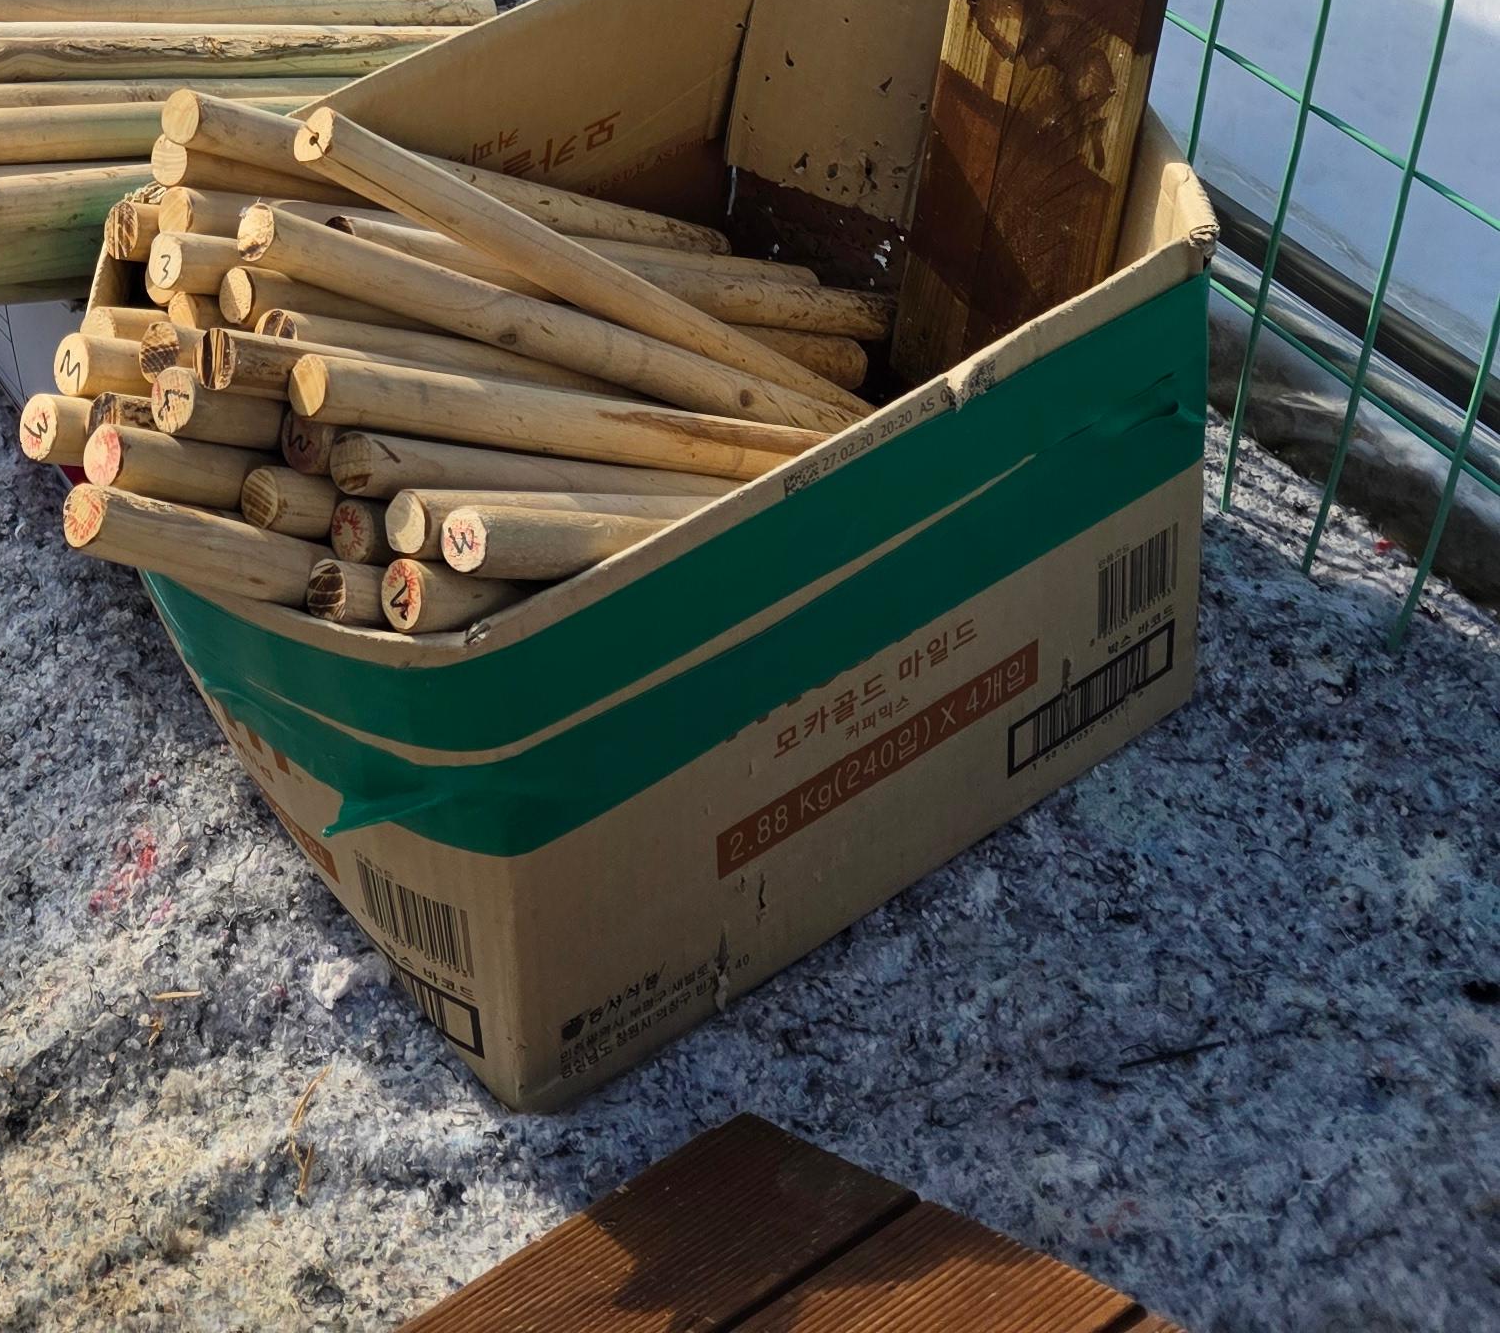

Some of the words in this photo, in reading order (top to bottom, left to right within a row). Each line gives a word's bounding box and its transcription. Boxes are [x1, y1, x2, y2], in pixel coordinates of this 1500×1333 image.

[821, 433, 875, 471] 27.02.20
[879, 410, 913, 439] 20:20
[919, 397, 936, 417] AS
[1107, 635, 1132, 656] 박스
[1137, 604, 1175, 635] 바코드
[773, 673, 887, 759] 모카골드
[898, 618, 978, 681] 마일드
[844, 694, 910, 741] 커피믹스
[729, 803, 790, 863] 2.88
[965, 654, 1027, 714] 4개입
[422, 966, 477, 1002] 바코드
